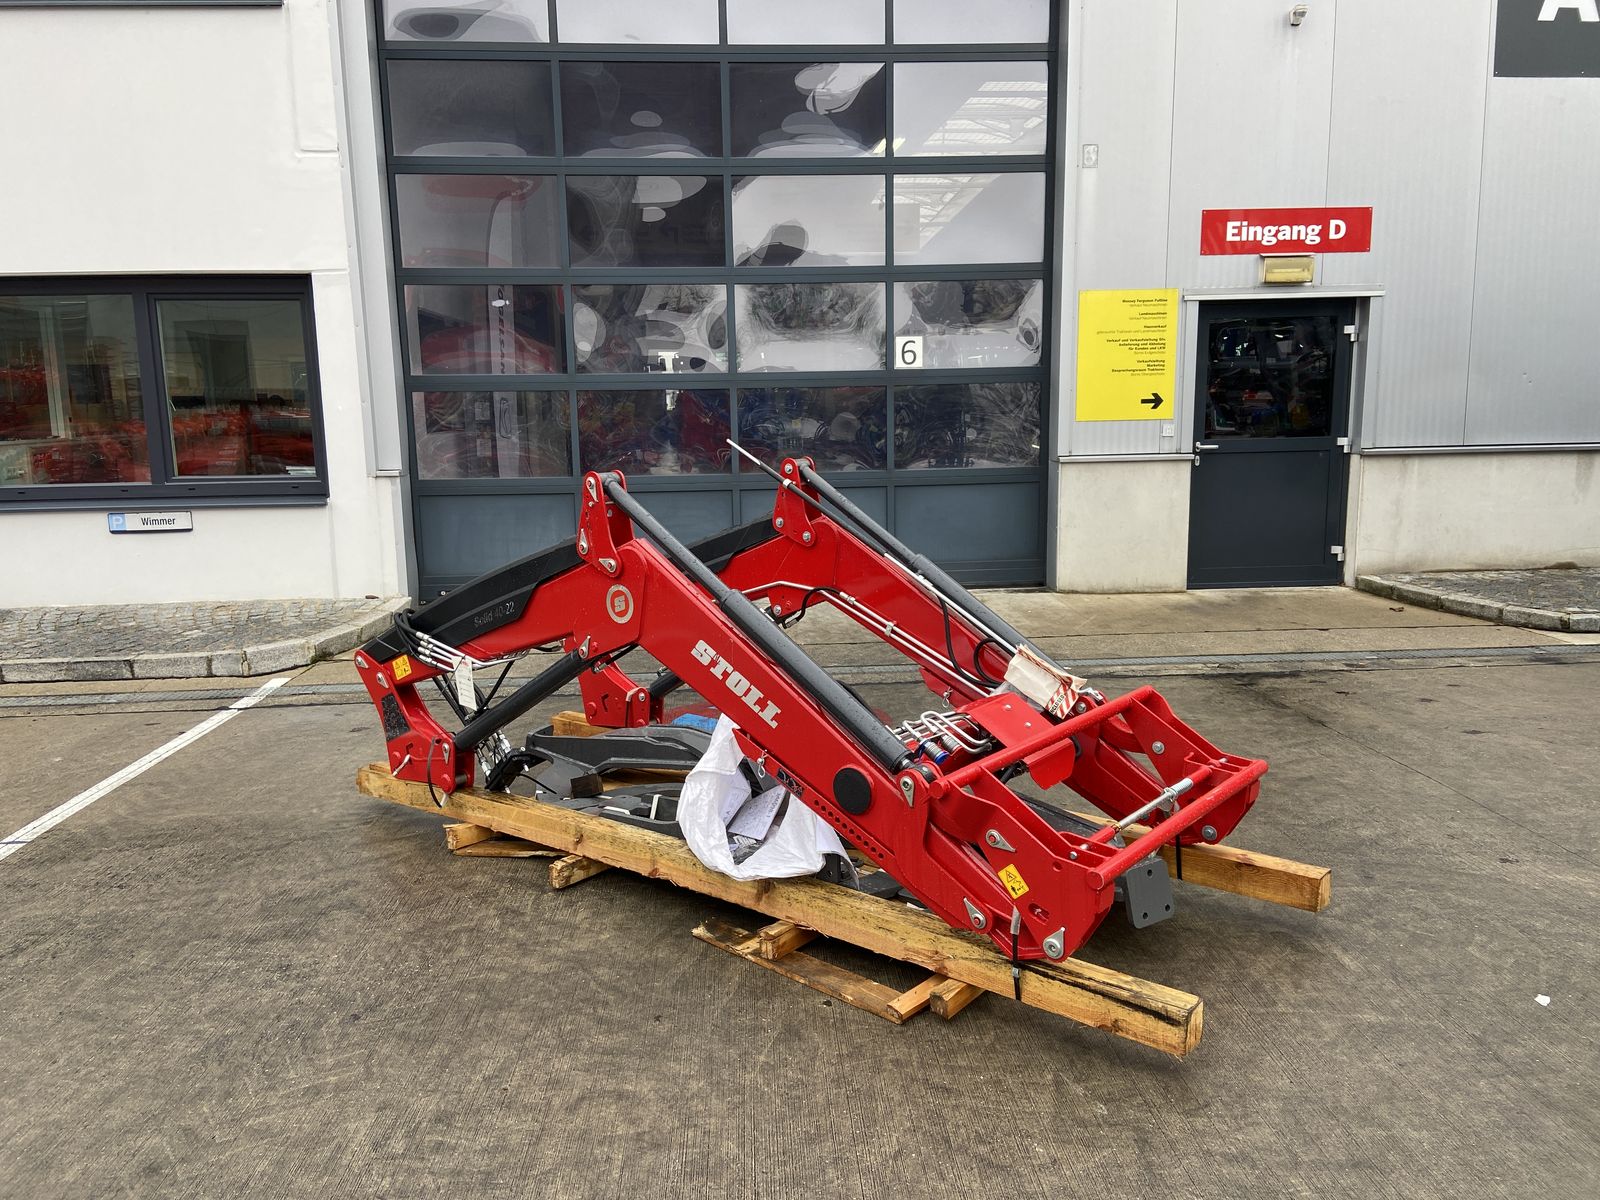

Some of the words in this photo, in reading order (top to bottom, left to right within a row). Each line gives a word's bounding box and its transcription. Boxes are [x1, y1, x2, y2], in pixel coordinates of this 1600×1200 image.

[1225, 219, 1321, 245] Eingang
[1329, 219, 1347, 240] D
[900, 340, 916, 365] 6
[141, 517, 176, 526] Wimmer
[690, 639, 782, 729] STOLL
